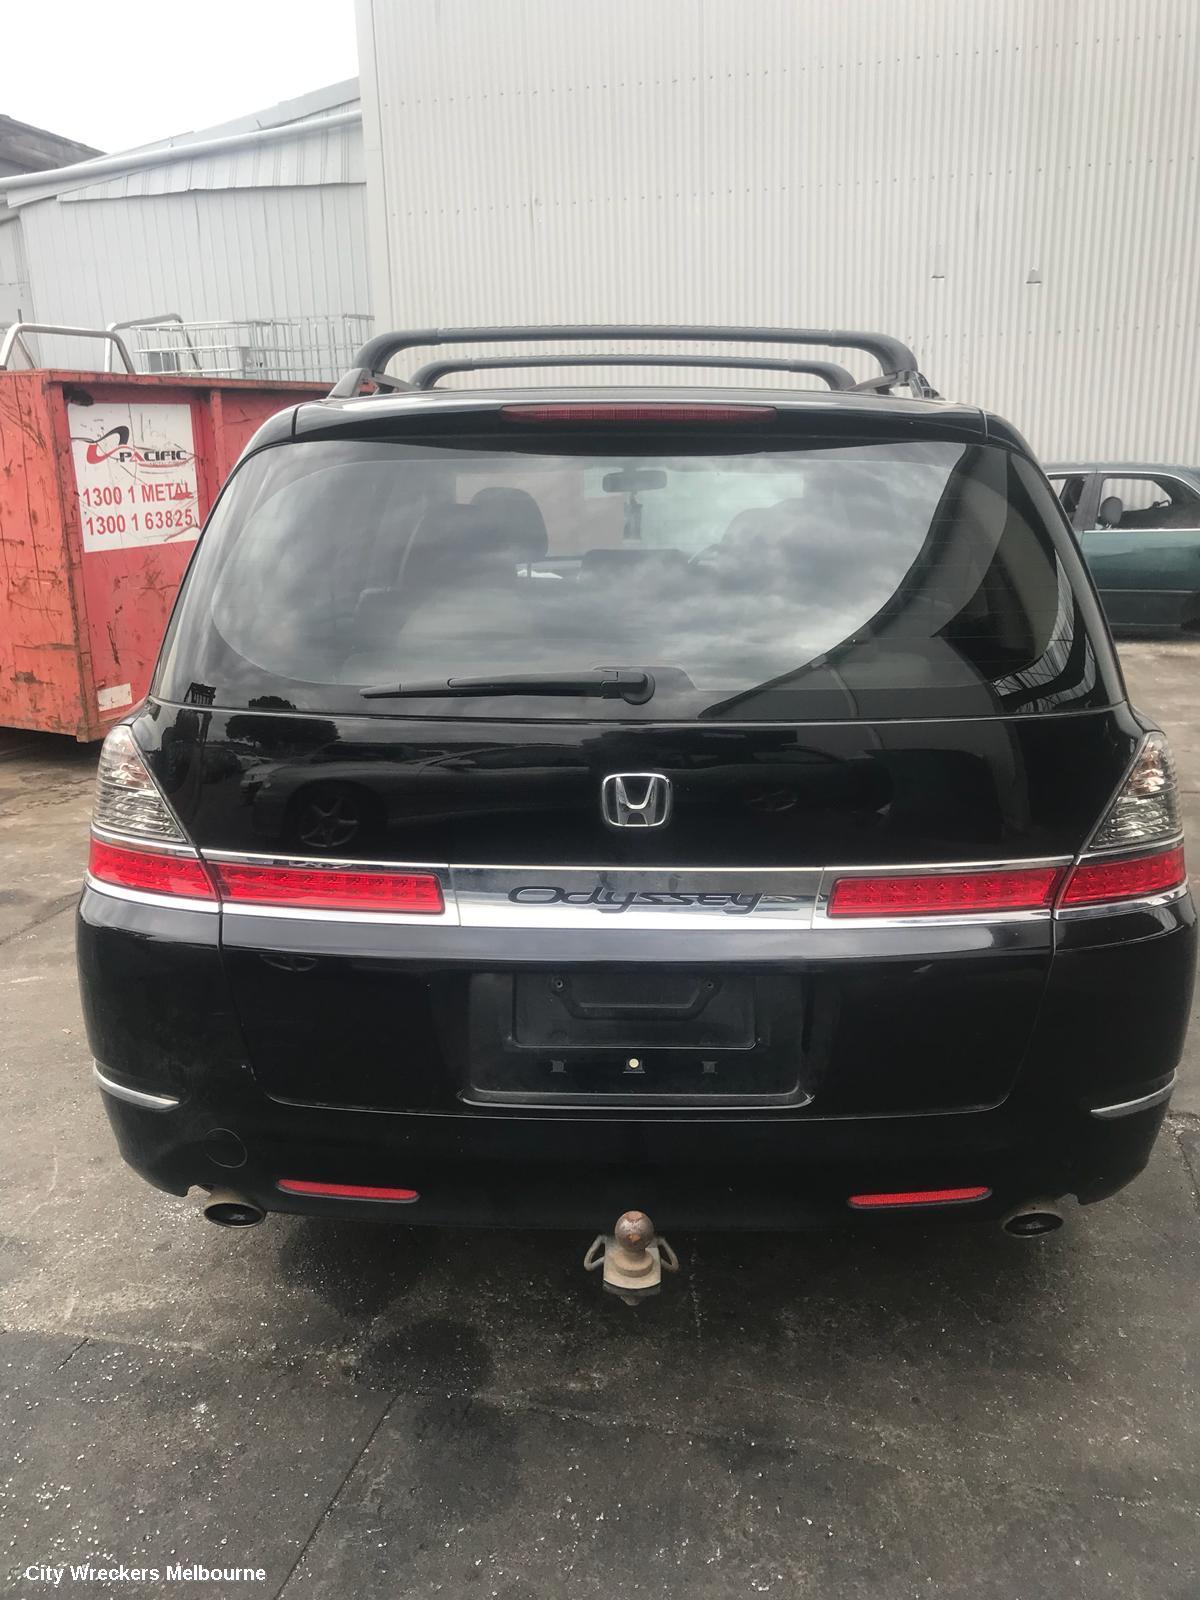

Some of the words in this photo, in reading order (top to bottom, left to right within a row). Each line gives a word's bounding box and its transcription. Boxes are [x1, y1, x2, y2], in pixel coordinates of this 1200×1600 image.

[119, 450, 187, 462] PACIFIC
[83, 486, 122, 507] 1300
[128, 485, 135, 503] 1
[141, 482, 194, 503] METAL
[86, 514, 126, 536] 1300
[131, 513, 139, 531] 1
[144, 508, 193, 530] 63825
[507, 886, 764, 915] Odyssey
